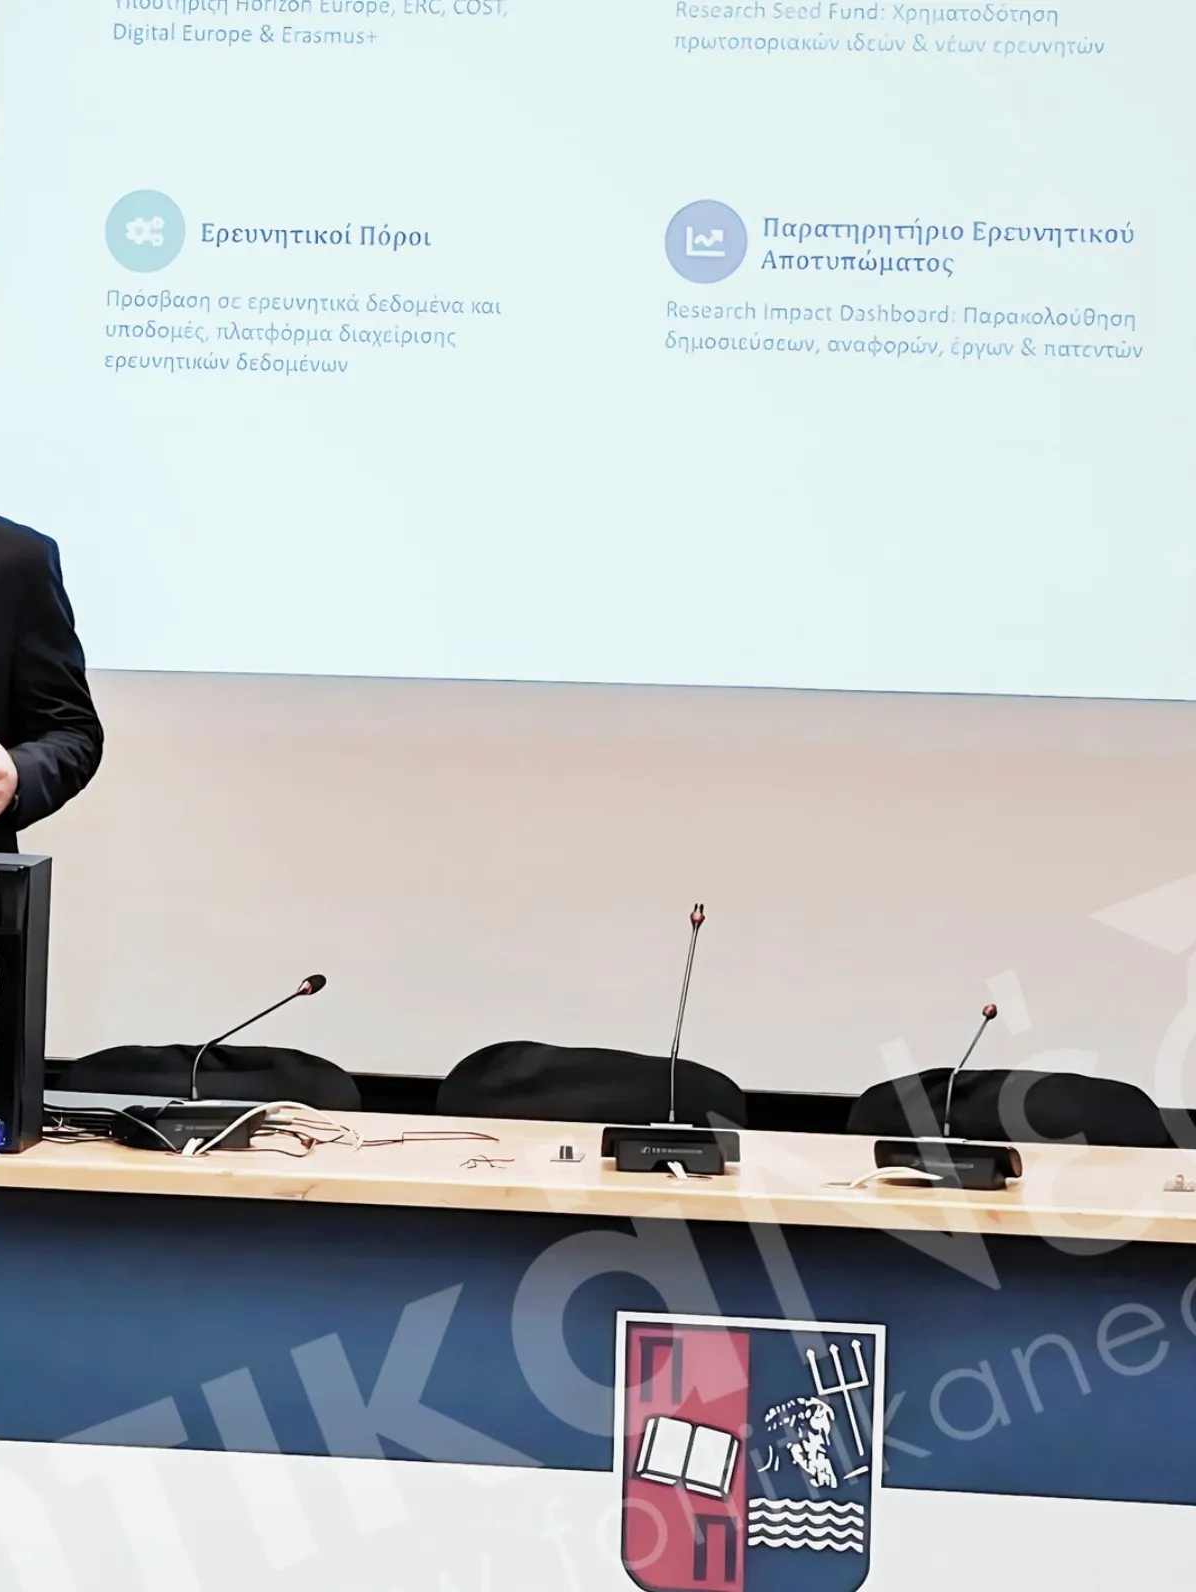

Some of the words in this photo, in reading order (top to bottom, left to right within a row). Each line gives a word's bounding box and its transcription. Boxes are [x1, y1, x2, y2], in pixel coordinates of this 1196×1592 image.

[236, 0, 312, 12] Horizon
[320, 0, 396, 17] Europe,
[403, 0, 446, 17] ERC,
[452, 0, 508, 18] COST,
[675, 0, 766, 19] Research
[772, 1, 822, 20] Seed
[828, 1, 885, 21] Fund:
[892, 2, 1059, 28] Χρηματοδότηση
[112, 22, 176, 46] Digital
[182, 24, 253, 47] Europe
[259, 23, 275, 44] &
[281, 25, 378, 45] Erasmus+
[674, 32, 840, 55] πρωτοποριακών
[846, 31, 906, 52] ιδεών
[912, 33, 929, 53] &
[934, 34, 987, 53] νέων
[992, 36, 1105, 58] ερευνητών
[200, 222, 353, 250] Ερευνητικοί
[359, 222, 432, 253] Πόροι
[762, 216, 965, 251] Παρατηρητήριο
[972, 219, 1135, 249] Ερευνητικού
[760, 248, 955, 279] Αποτυπώματος
[106, 288, 211, 313] Πρόσβαση
[217, 295, 242, 310] σε
[247, 293, 360, 315] ερευνητικά
[366, 292, 465, 316] δεδομένα
[471, 300, 502, 315] και
[666, 300, 757, 320] Research
[763, 303, 833, 325] Impact
[839, 303, 956, 324] Dashboard:
[963, 306, 1136, 332] Παρακολούθηση
[105, 319, 210, 344] υποδομές,
[216, 321, 333, 346] πλατφόρμα
[338, 323, 457, 349] διαχείρισης
[664, 329, 820, 355] δημοσιεύσεων,
[827, 334, 944, 359] αναφορών,
[950, 336, 1015, 360] έργων
[1020, 336, 1037, 357] &
[1044, 340, 1144, 359] πατεντών
[104, 351, 231, 374] ερευνητικών
[235, 351, 349, 377] δεδομένων
